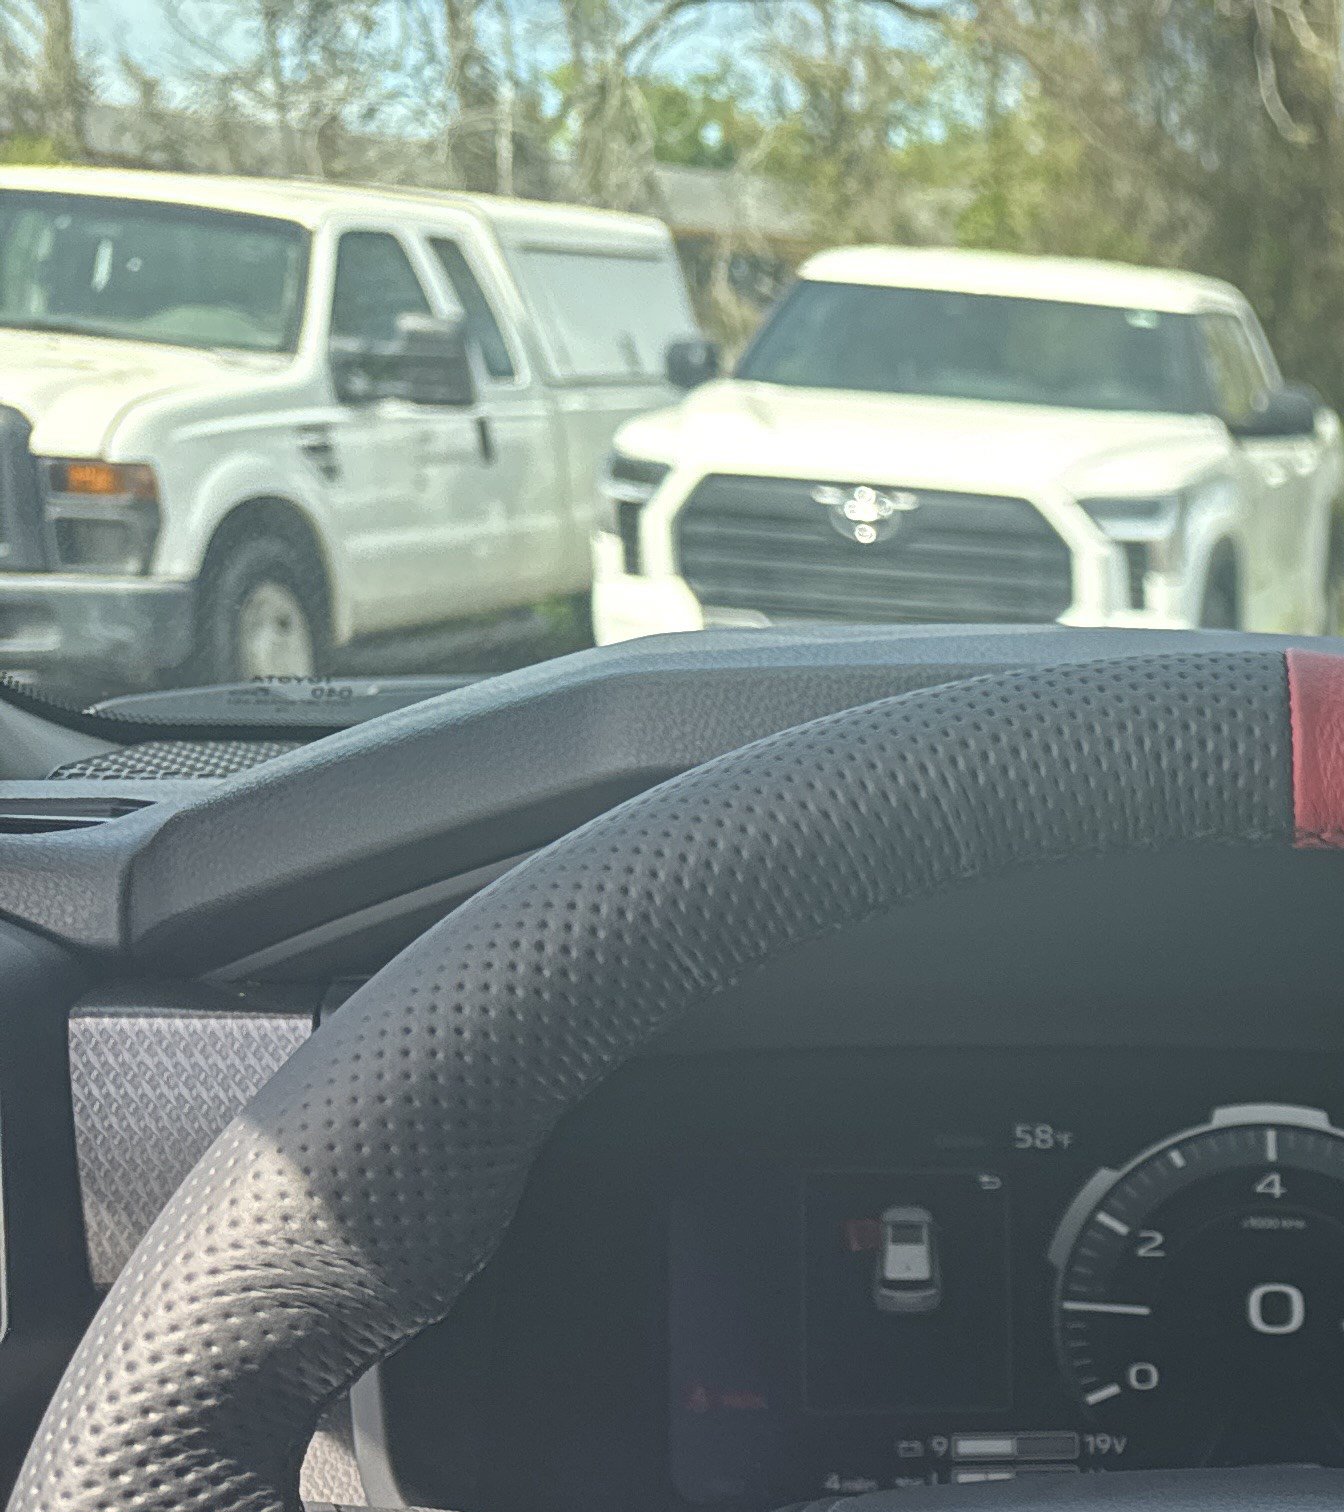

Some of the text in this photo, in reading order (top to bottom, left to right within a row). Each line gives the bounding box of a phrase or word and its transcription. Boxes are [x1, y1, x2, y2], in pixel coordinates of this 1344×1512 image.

[1255, 1173, 1287, 1199] 4
[1136, 1231, 1166, 1258] 2
[1247, 1282, 1306, 1335] 0
[1127, 1362, 1160, 1391] 0
[931, 1434, 950, 1457] 9
